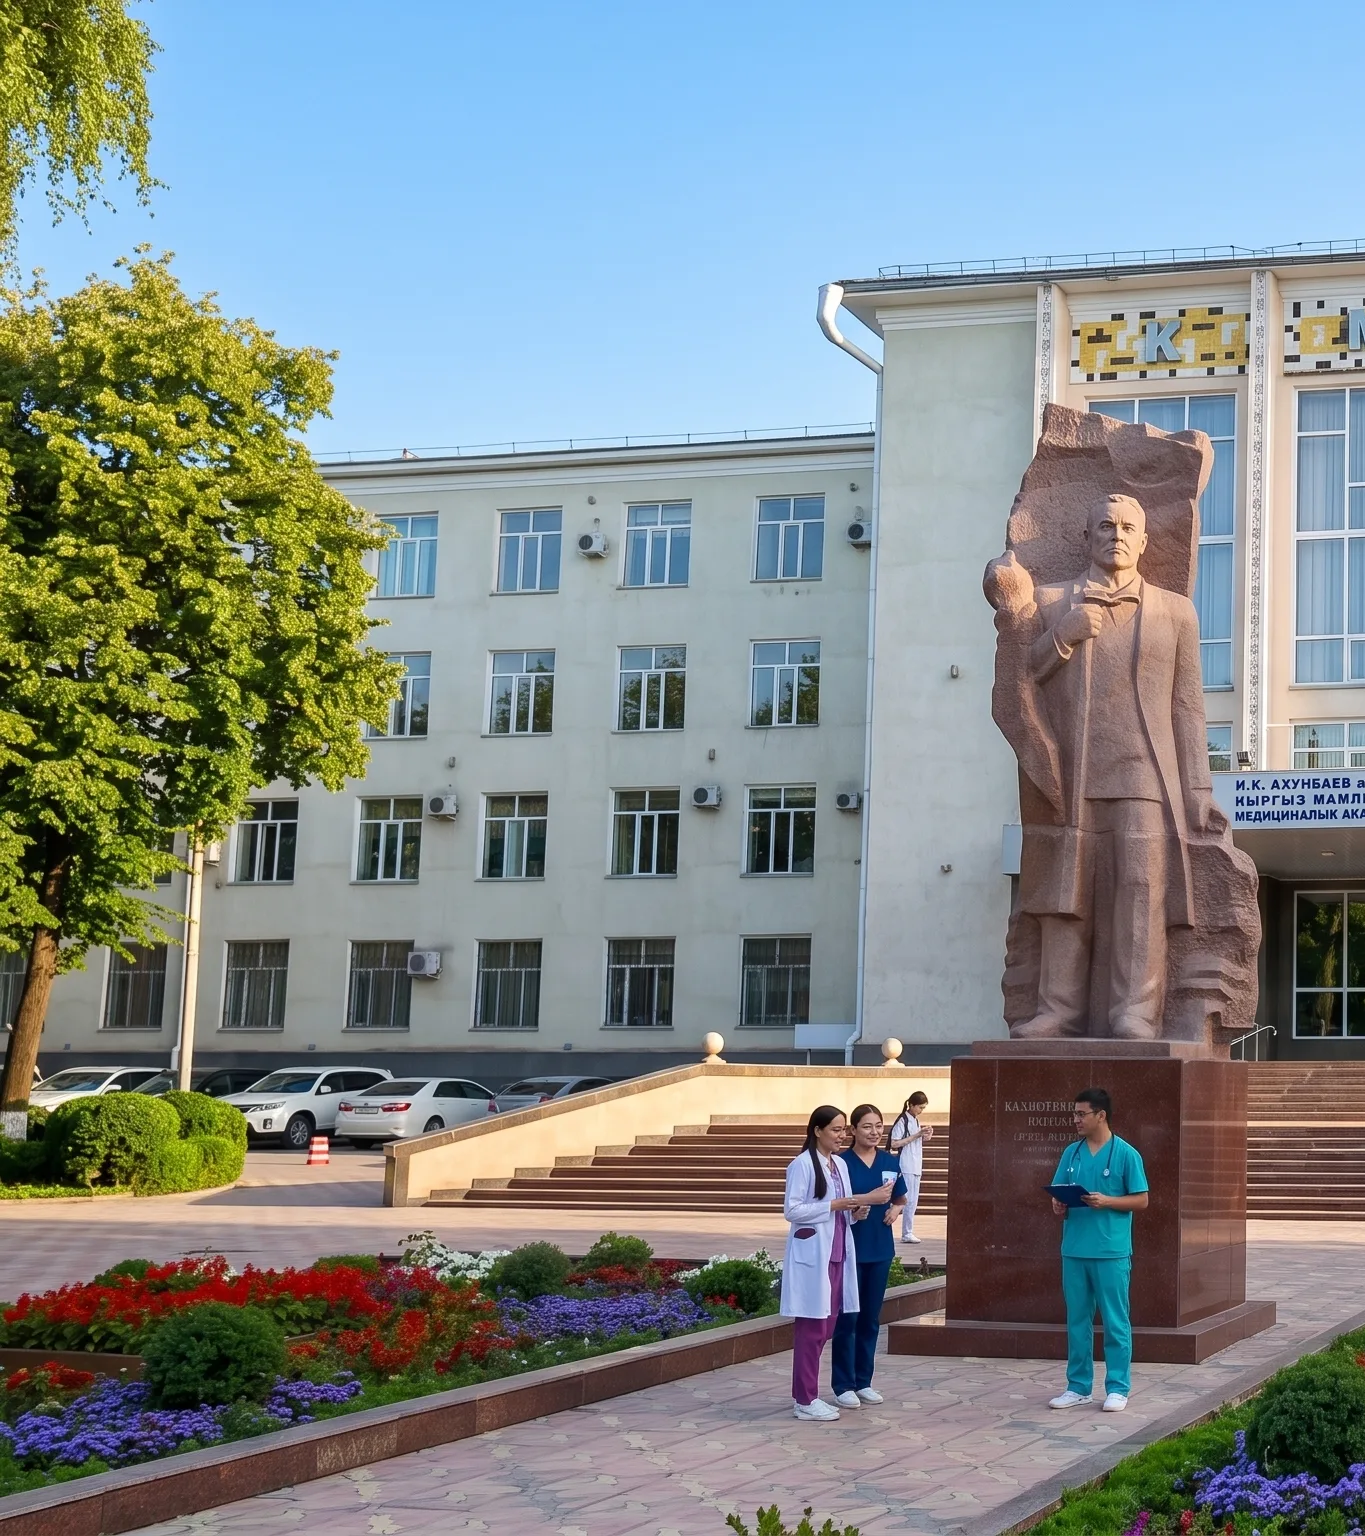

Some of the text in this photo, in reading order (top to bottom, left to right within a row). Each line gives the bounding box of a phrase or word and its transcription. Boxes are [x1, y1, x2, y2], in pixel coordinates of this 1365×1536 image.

[1145, 320, 1182, 363] К
[1235, 779, 1266, 792] И.К.
[1270, 777, 1351, 791] АХУНБАЕВ
[1235, 794, 1306, 807] КЫРГЫЗ
[1235, 809, 1339, 824] МЕДИЦИНАЛЫК
